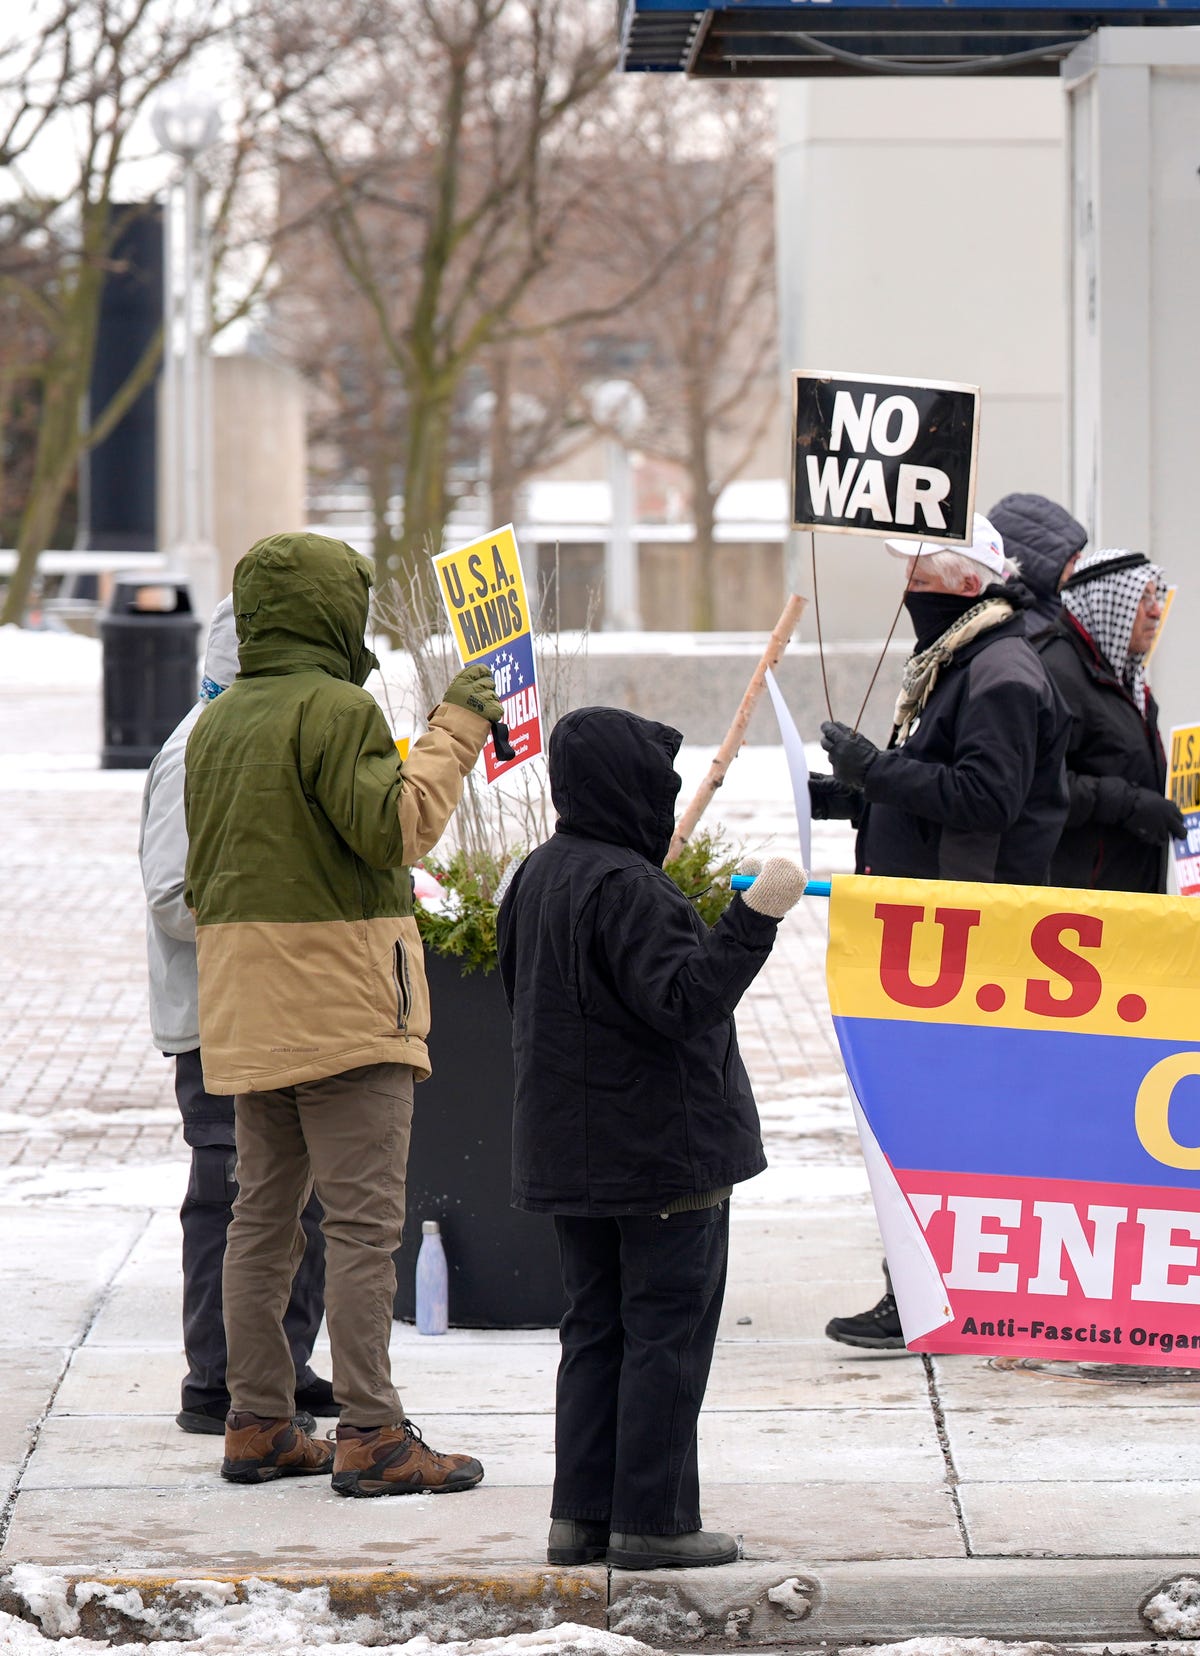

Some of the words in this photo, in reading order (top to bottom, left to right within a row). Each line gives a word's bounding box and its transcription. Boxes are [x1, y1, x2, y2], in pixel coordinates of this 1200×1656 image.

[829, 391, 920, 457] NO
[806, 454, 951, 530] WAR
[442, 544, 515, 609] U.S.A.
[457, 588, 523, 655] HANDS
[494, 663, 512, 698] OFF
[874, 903, 1147, 1023] U.S.
[961, 1317, 1122, 1345] Anti-Fascist
